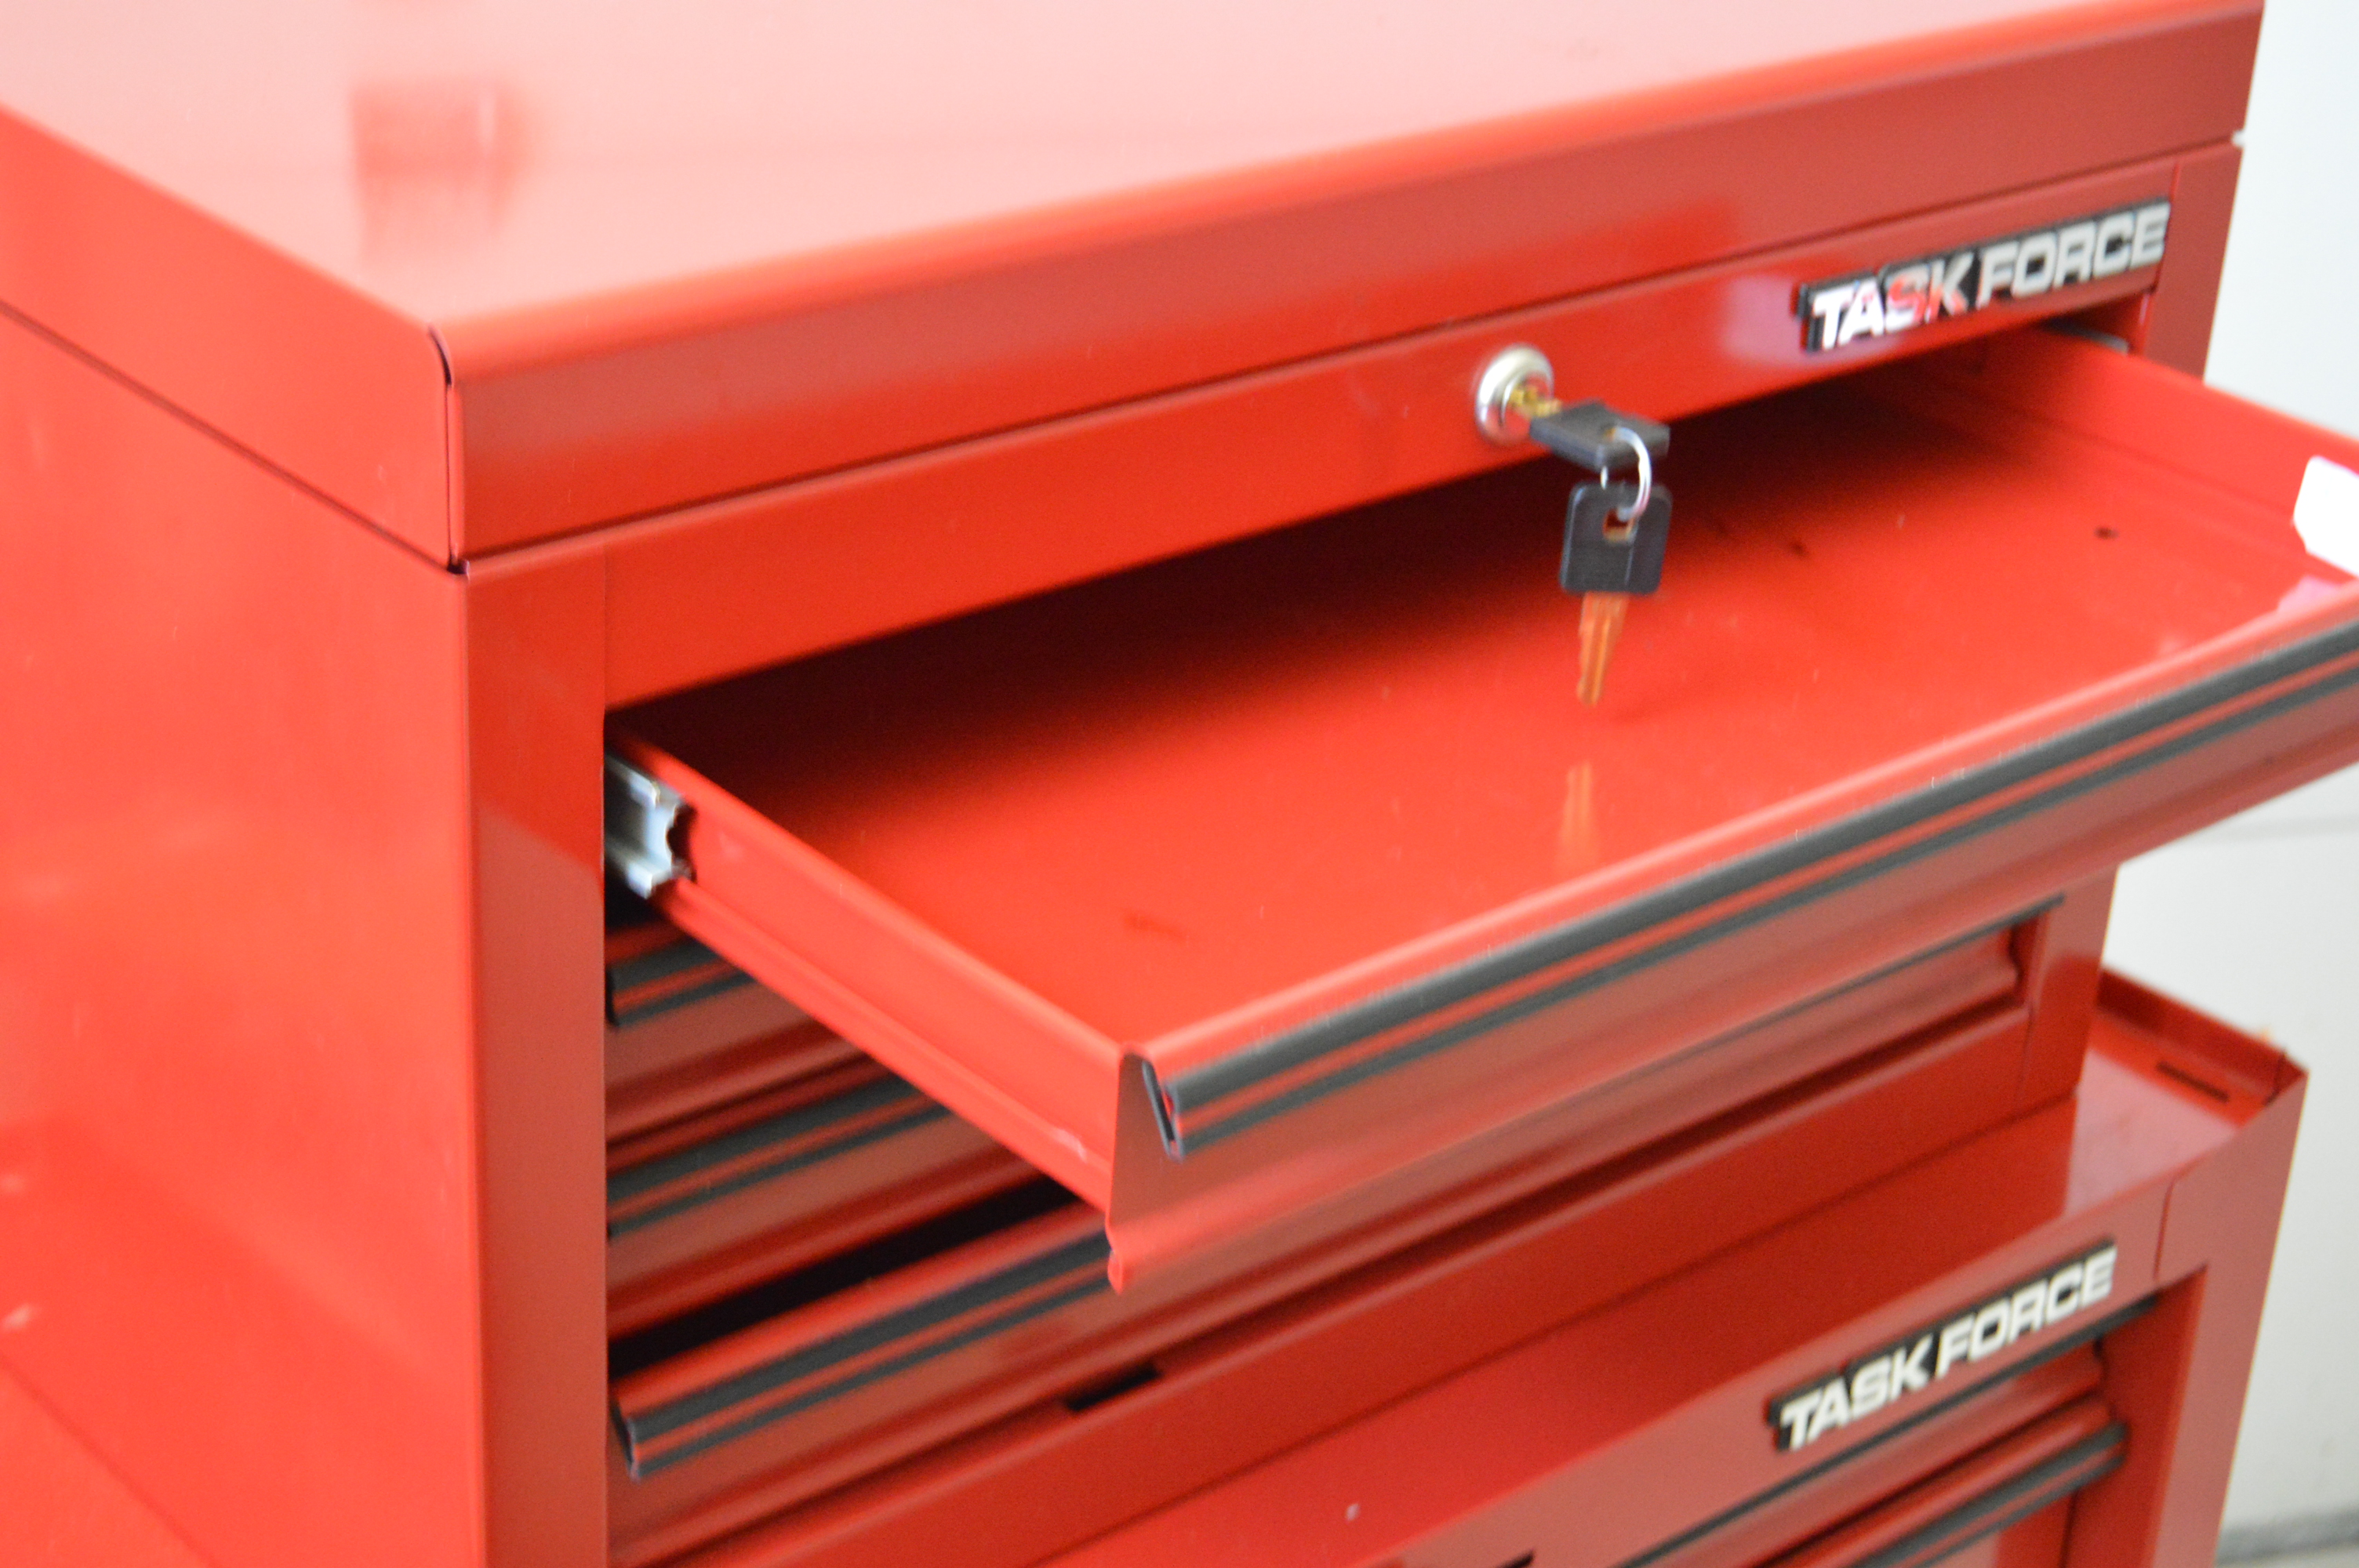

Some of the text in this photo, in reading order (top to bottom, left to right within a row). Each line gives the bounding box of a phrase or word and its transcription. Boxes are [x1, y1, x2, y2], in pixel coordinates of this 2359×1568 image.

[1811, 201, 2172, 350] TASK FORCE
[1779, 1246, 2118, 1451] TASK FORCE
